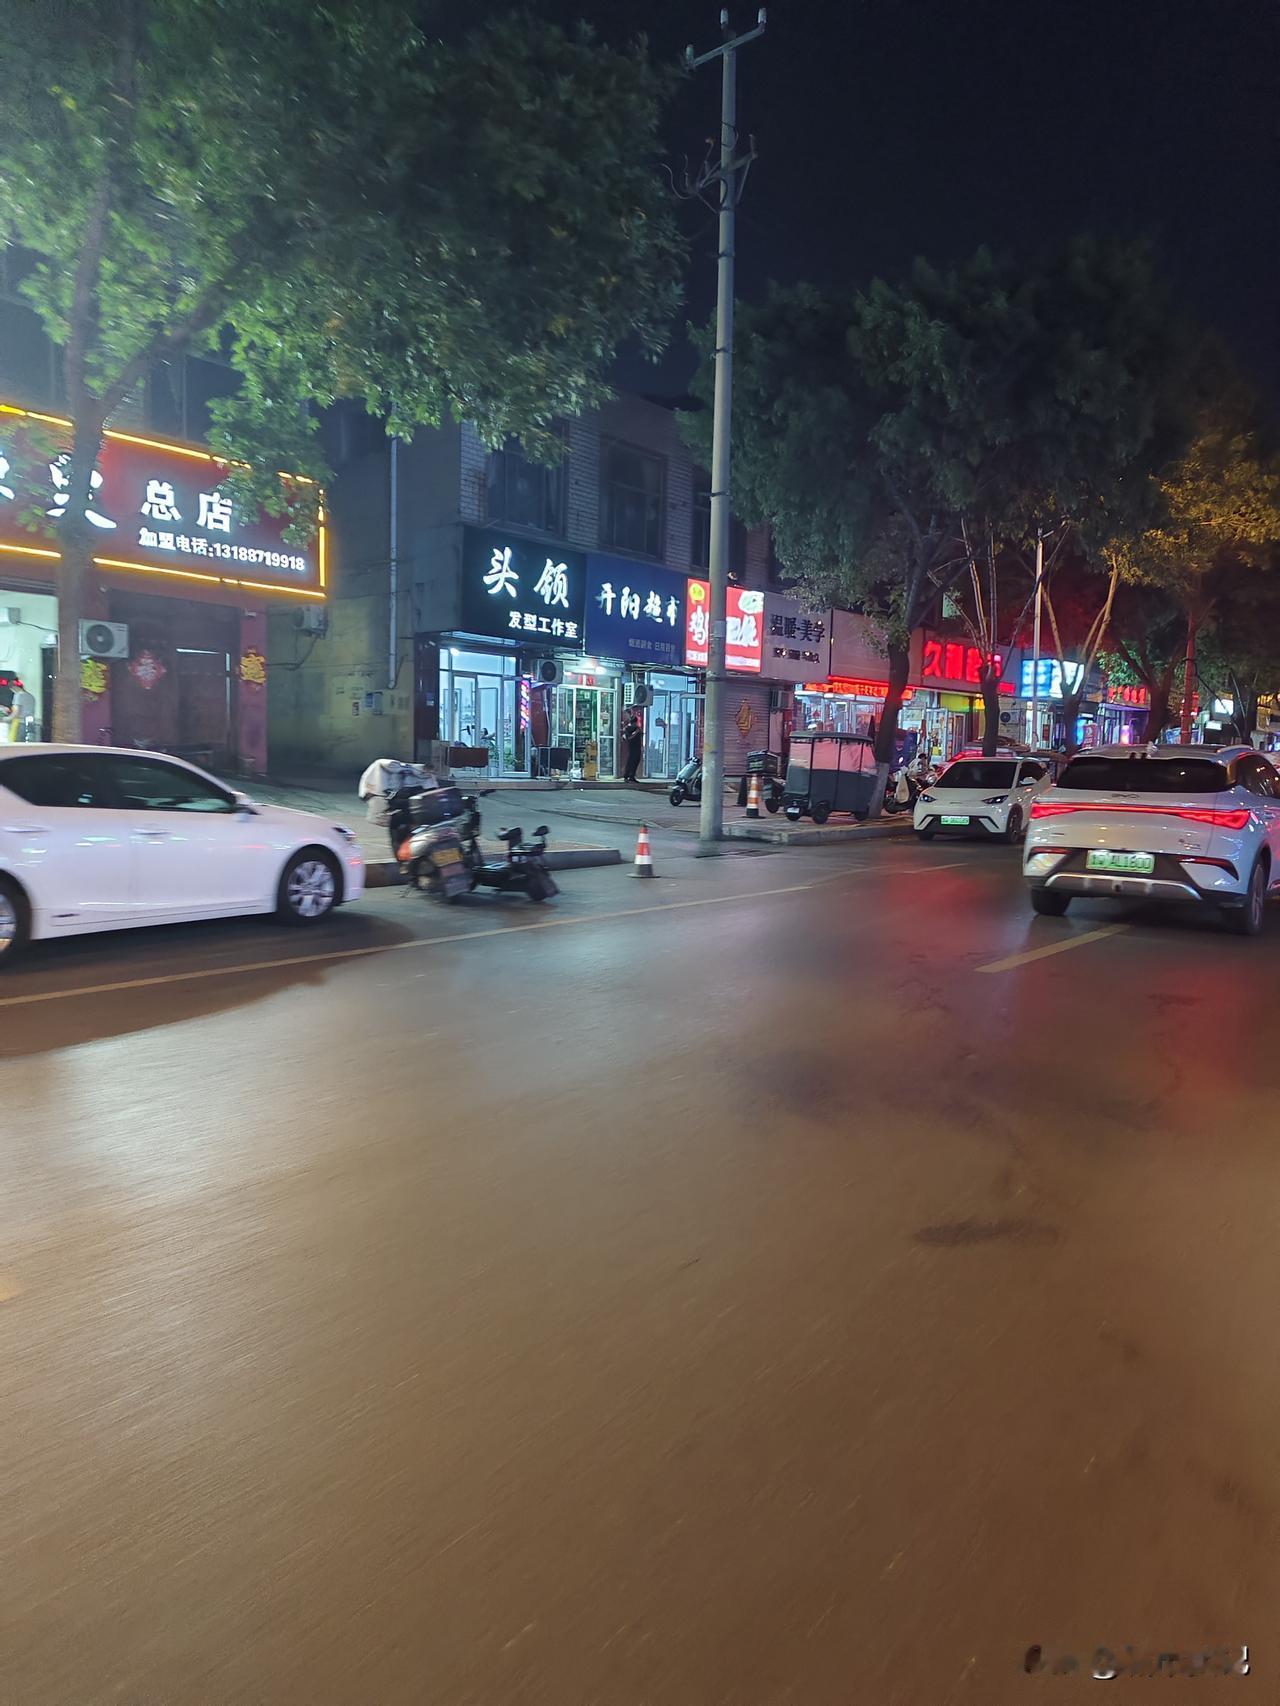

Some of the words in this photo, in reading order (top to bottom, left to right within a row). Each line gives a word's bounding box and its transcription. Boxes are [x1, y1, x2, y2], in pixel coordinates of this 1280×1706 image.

[140, 479, 233, 533] 总店
[508, 610, 578, 639] 发型工作室
